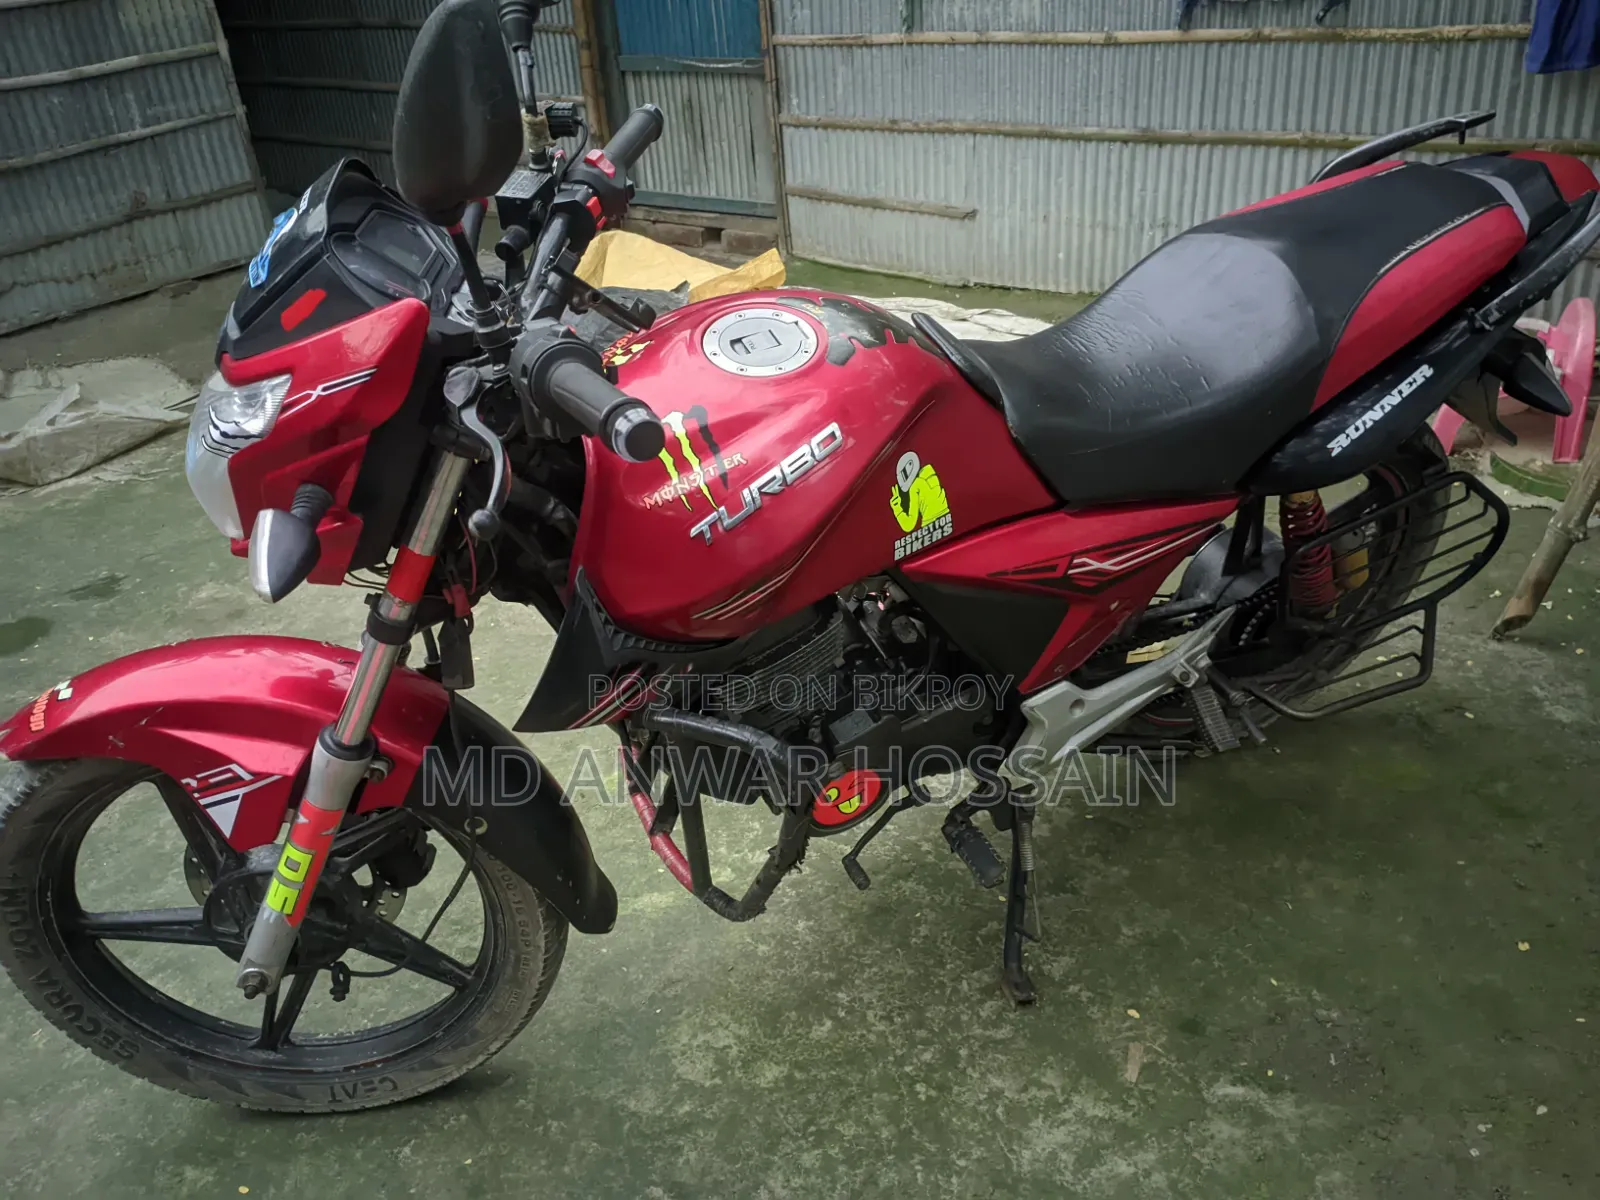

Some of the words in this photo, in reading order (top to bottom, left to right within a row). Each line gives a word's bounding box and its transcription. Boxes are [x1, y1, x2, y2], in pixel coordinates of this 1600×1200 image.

[1326, 363, 1434, 458] RUNNER
[690, 422, 844, 546] TURBO
[894, 524, 935, 550] RESPECT
[934, 513, 952, 531] FOR
[894, 522, 953, 561] BIKERS
[28, 967, 141, 1060] SECURA
[327, 1076, 399, 1104] CEAT
